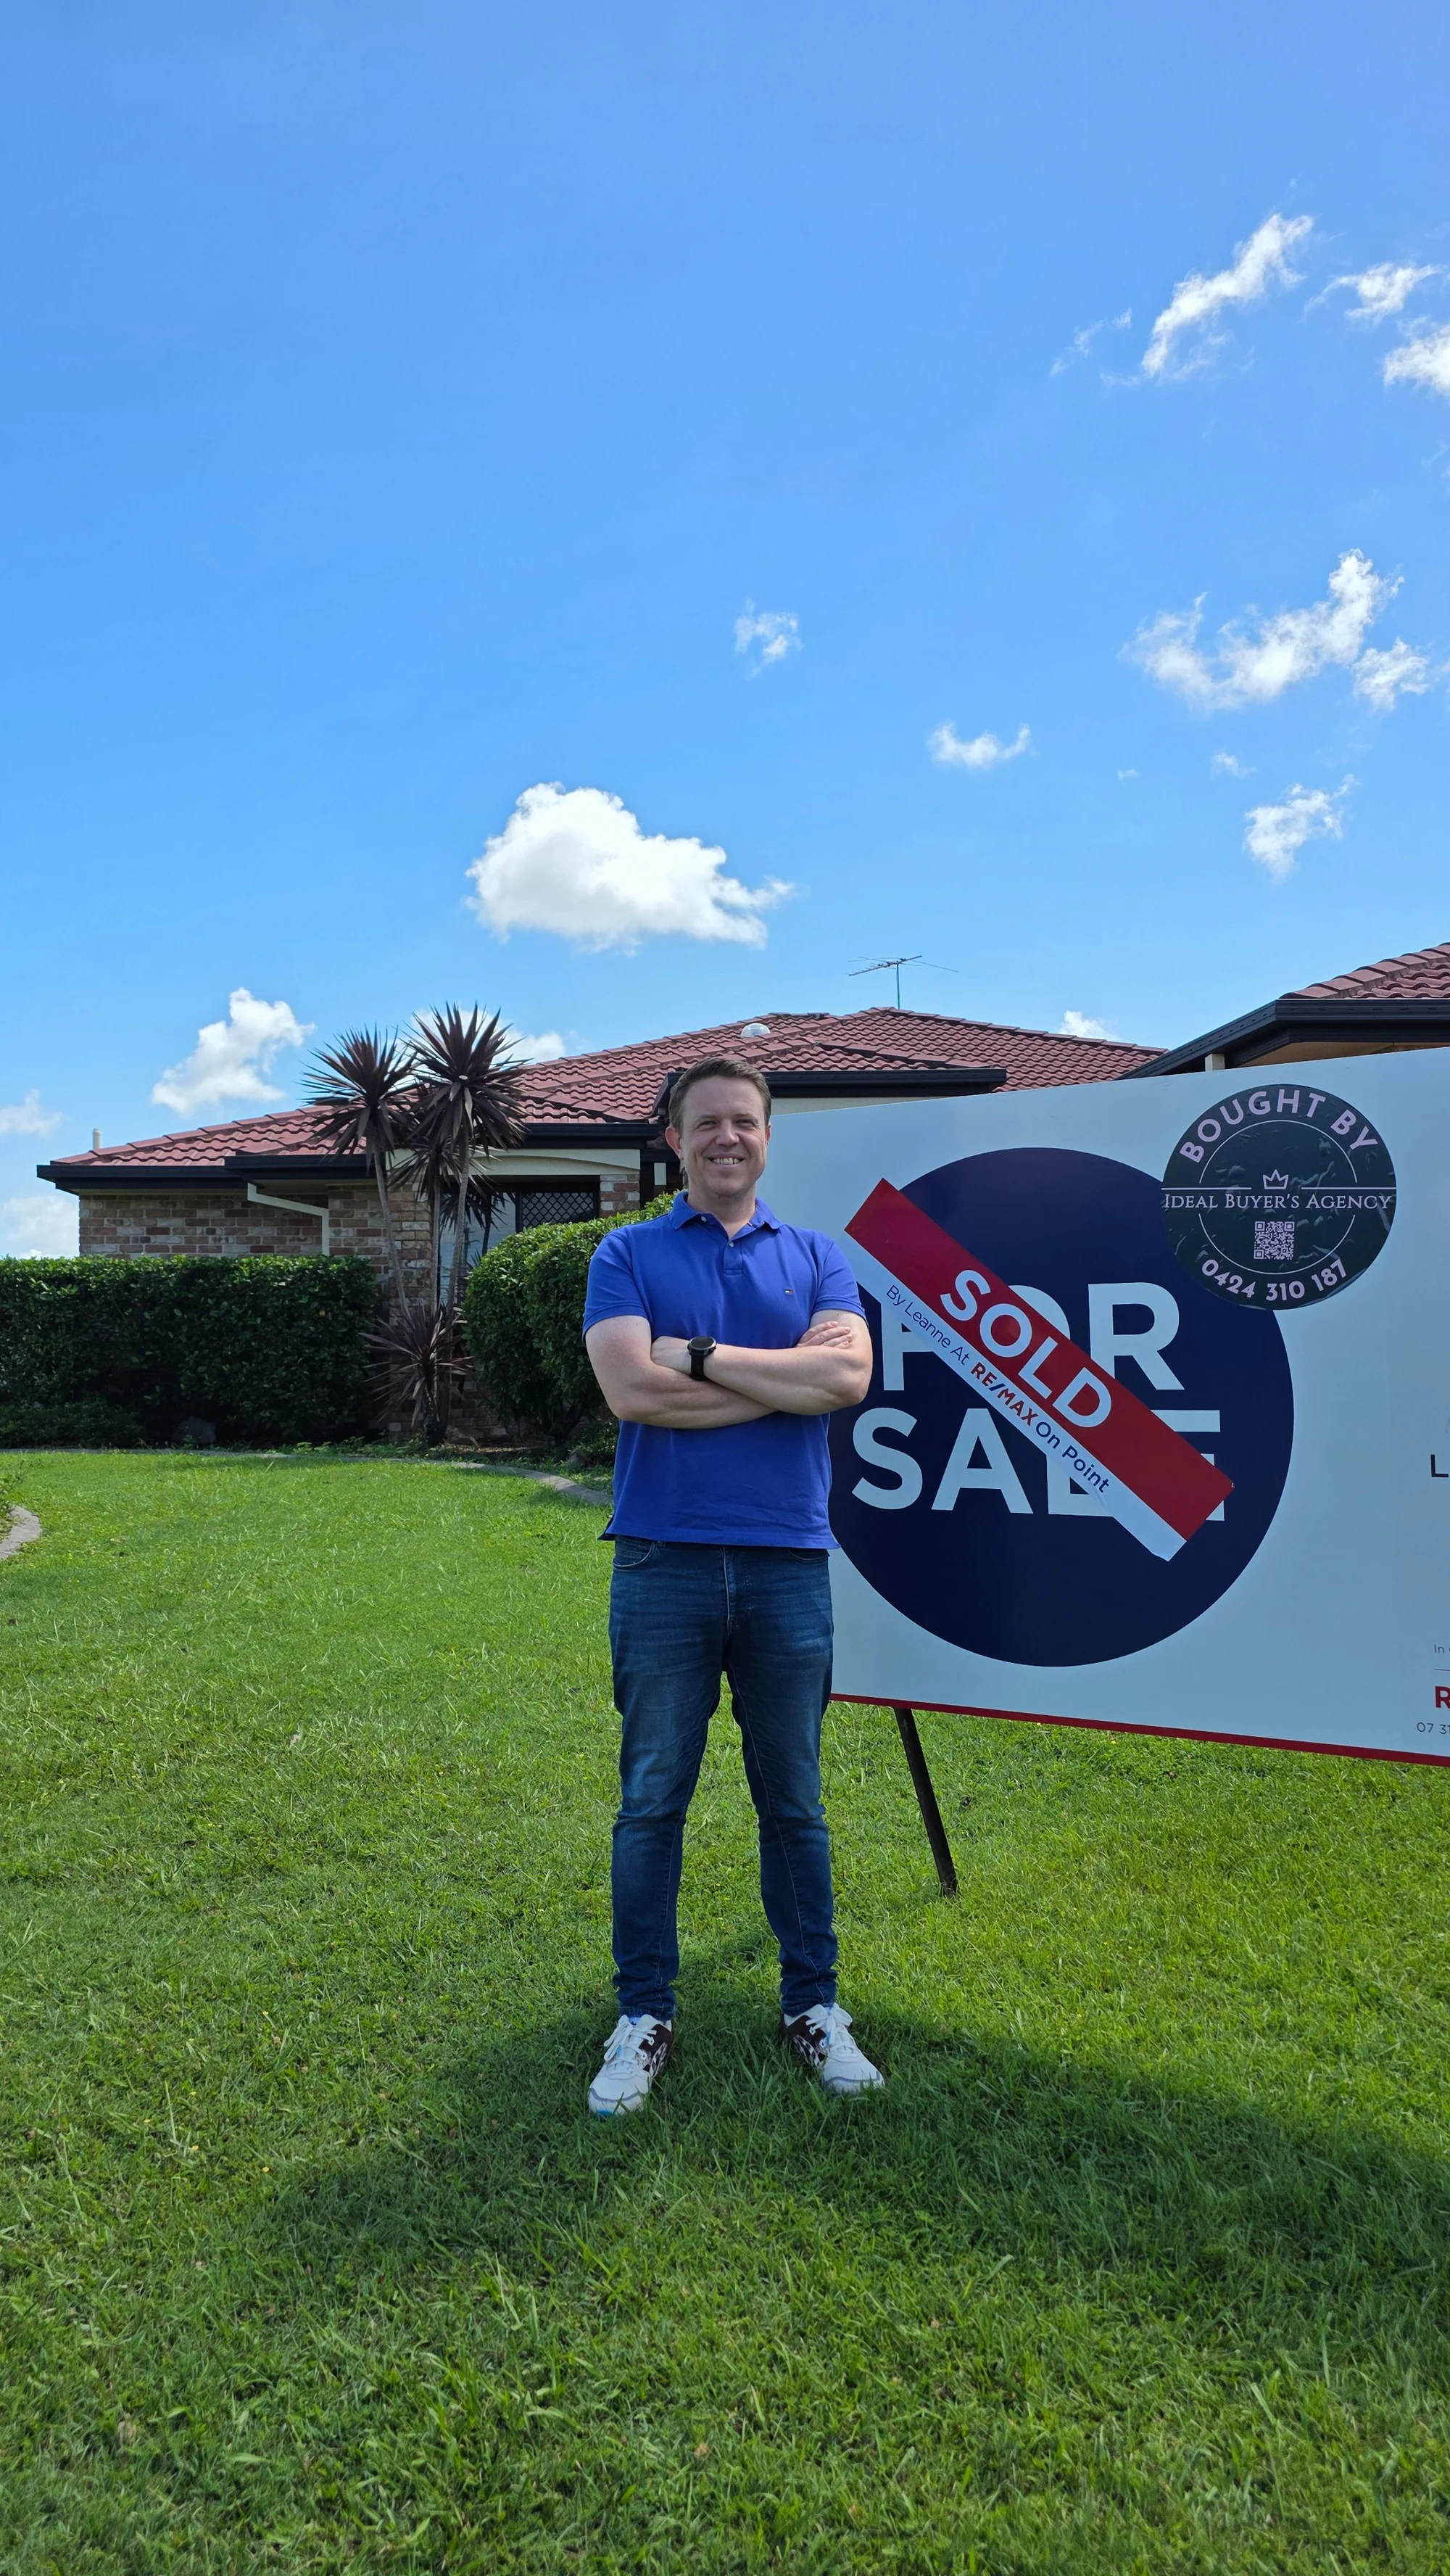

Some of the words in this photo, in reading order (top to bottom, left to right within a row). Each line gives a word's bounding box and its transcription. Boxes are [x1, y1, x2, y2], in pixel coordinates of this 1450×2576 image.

[1179, 1089, 1326, 1163] BOUGHT
[1330, 1110, 1378, 1151] BY
[1201, 1259, 1256, 1298] 0424
[1266, 1281, 1305, 1301] 310
[1312, 1258, 1346, 1291] 187
[940, 1270, 1111, 1428] SOLD
[886, 1285, 906, 1306] By
[905, 1302, 950, 1348] Leanne
[950, 1346, 969, 1365] At
[971, 1362, 1038, 1427] RE/MAX
[1035, 1421, 1061, 1449] On
[1062, 1445, 1109, 1493] Point
[1434, 1644, 1445, 1654] In
[1417, 1722, 1434, 1733] 07
